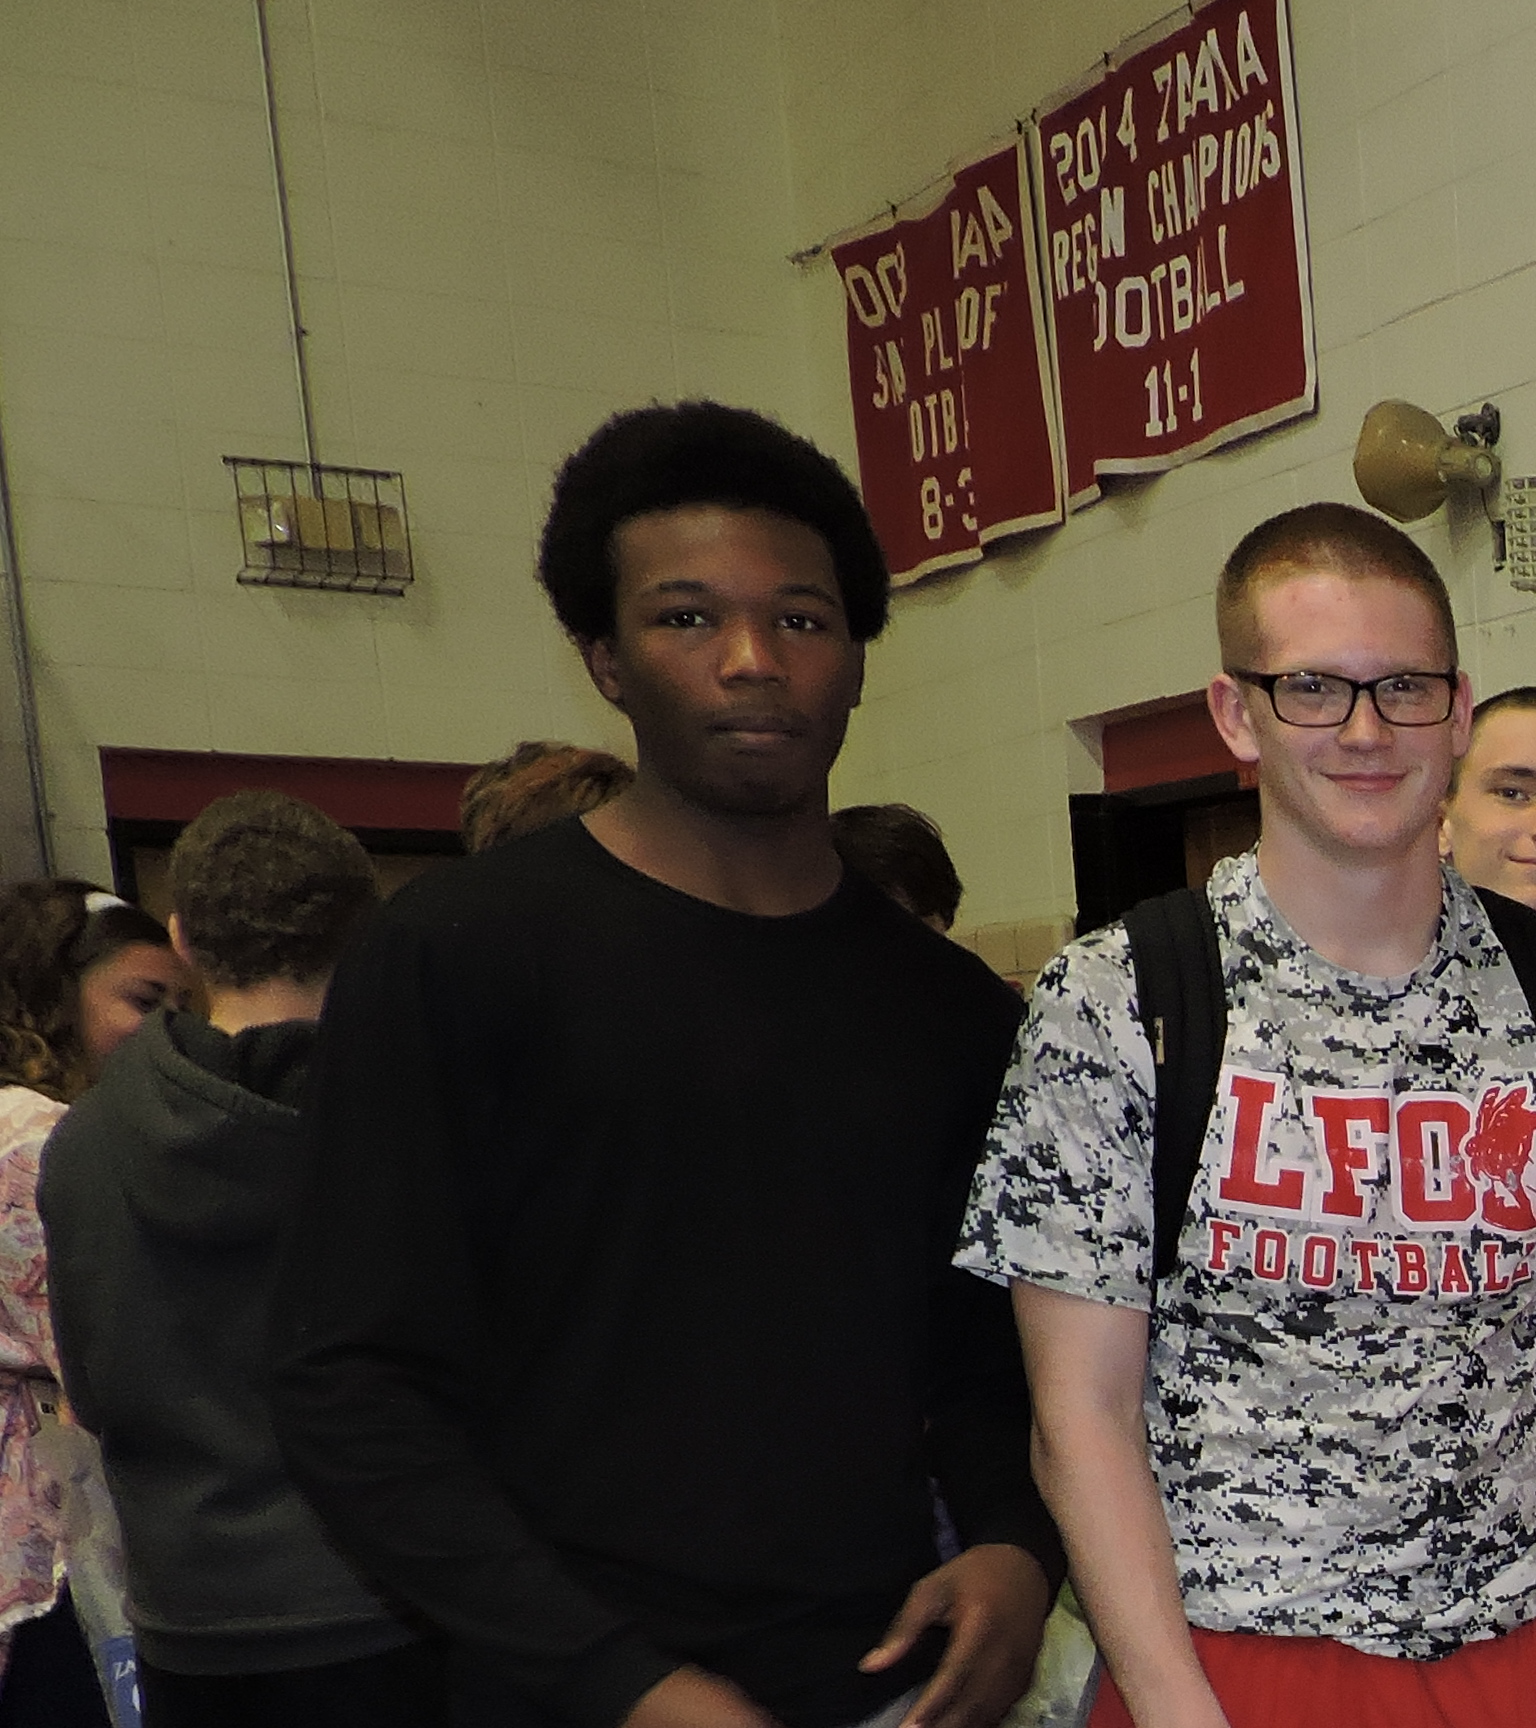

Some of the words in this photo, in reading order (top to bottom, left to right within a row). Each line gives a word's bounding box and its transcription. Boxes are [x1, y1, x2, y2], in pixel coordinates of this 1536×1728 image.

[1144, 347, 1203, 437] 11-1
[1214, 1069, 1481, 1228] LFO
[1206, 1219, 1534, 1296] FOOTBALL
